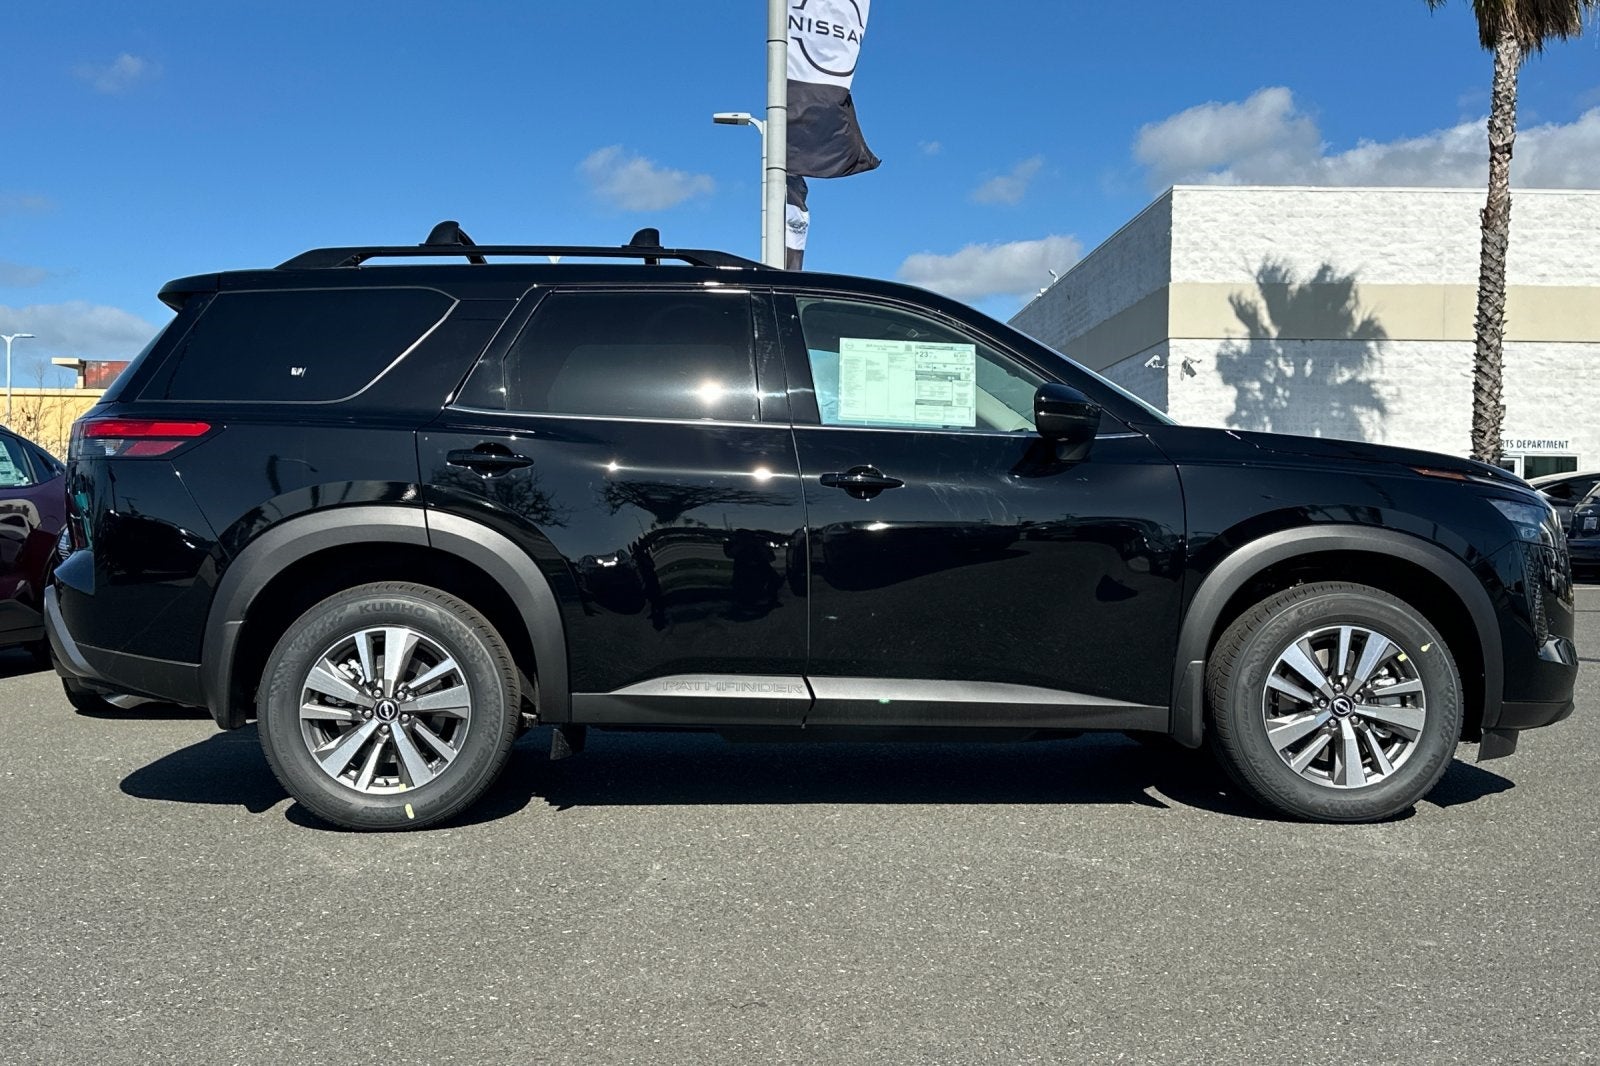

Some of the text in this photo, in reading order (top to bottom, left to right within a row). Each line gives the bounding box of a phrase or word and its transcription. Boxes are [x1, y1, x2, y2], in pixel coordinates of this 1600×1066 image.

[1501, 439, 1569, 449] RTS DEPARTMENT
[358, 602, 427, 617] KUMHO
[661, 680, 804, 694] PATHFINDER
